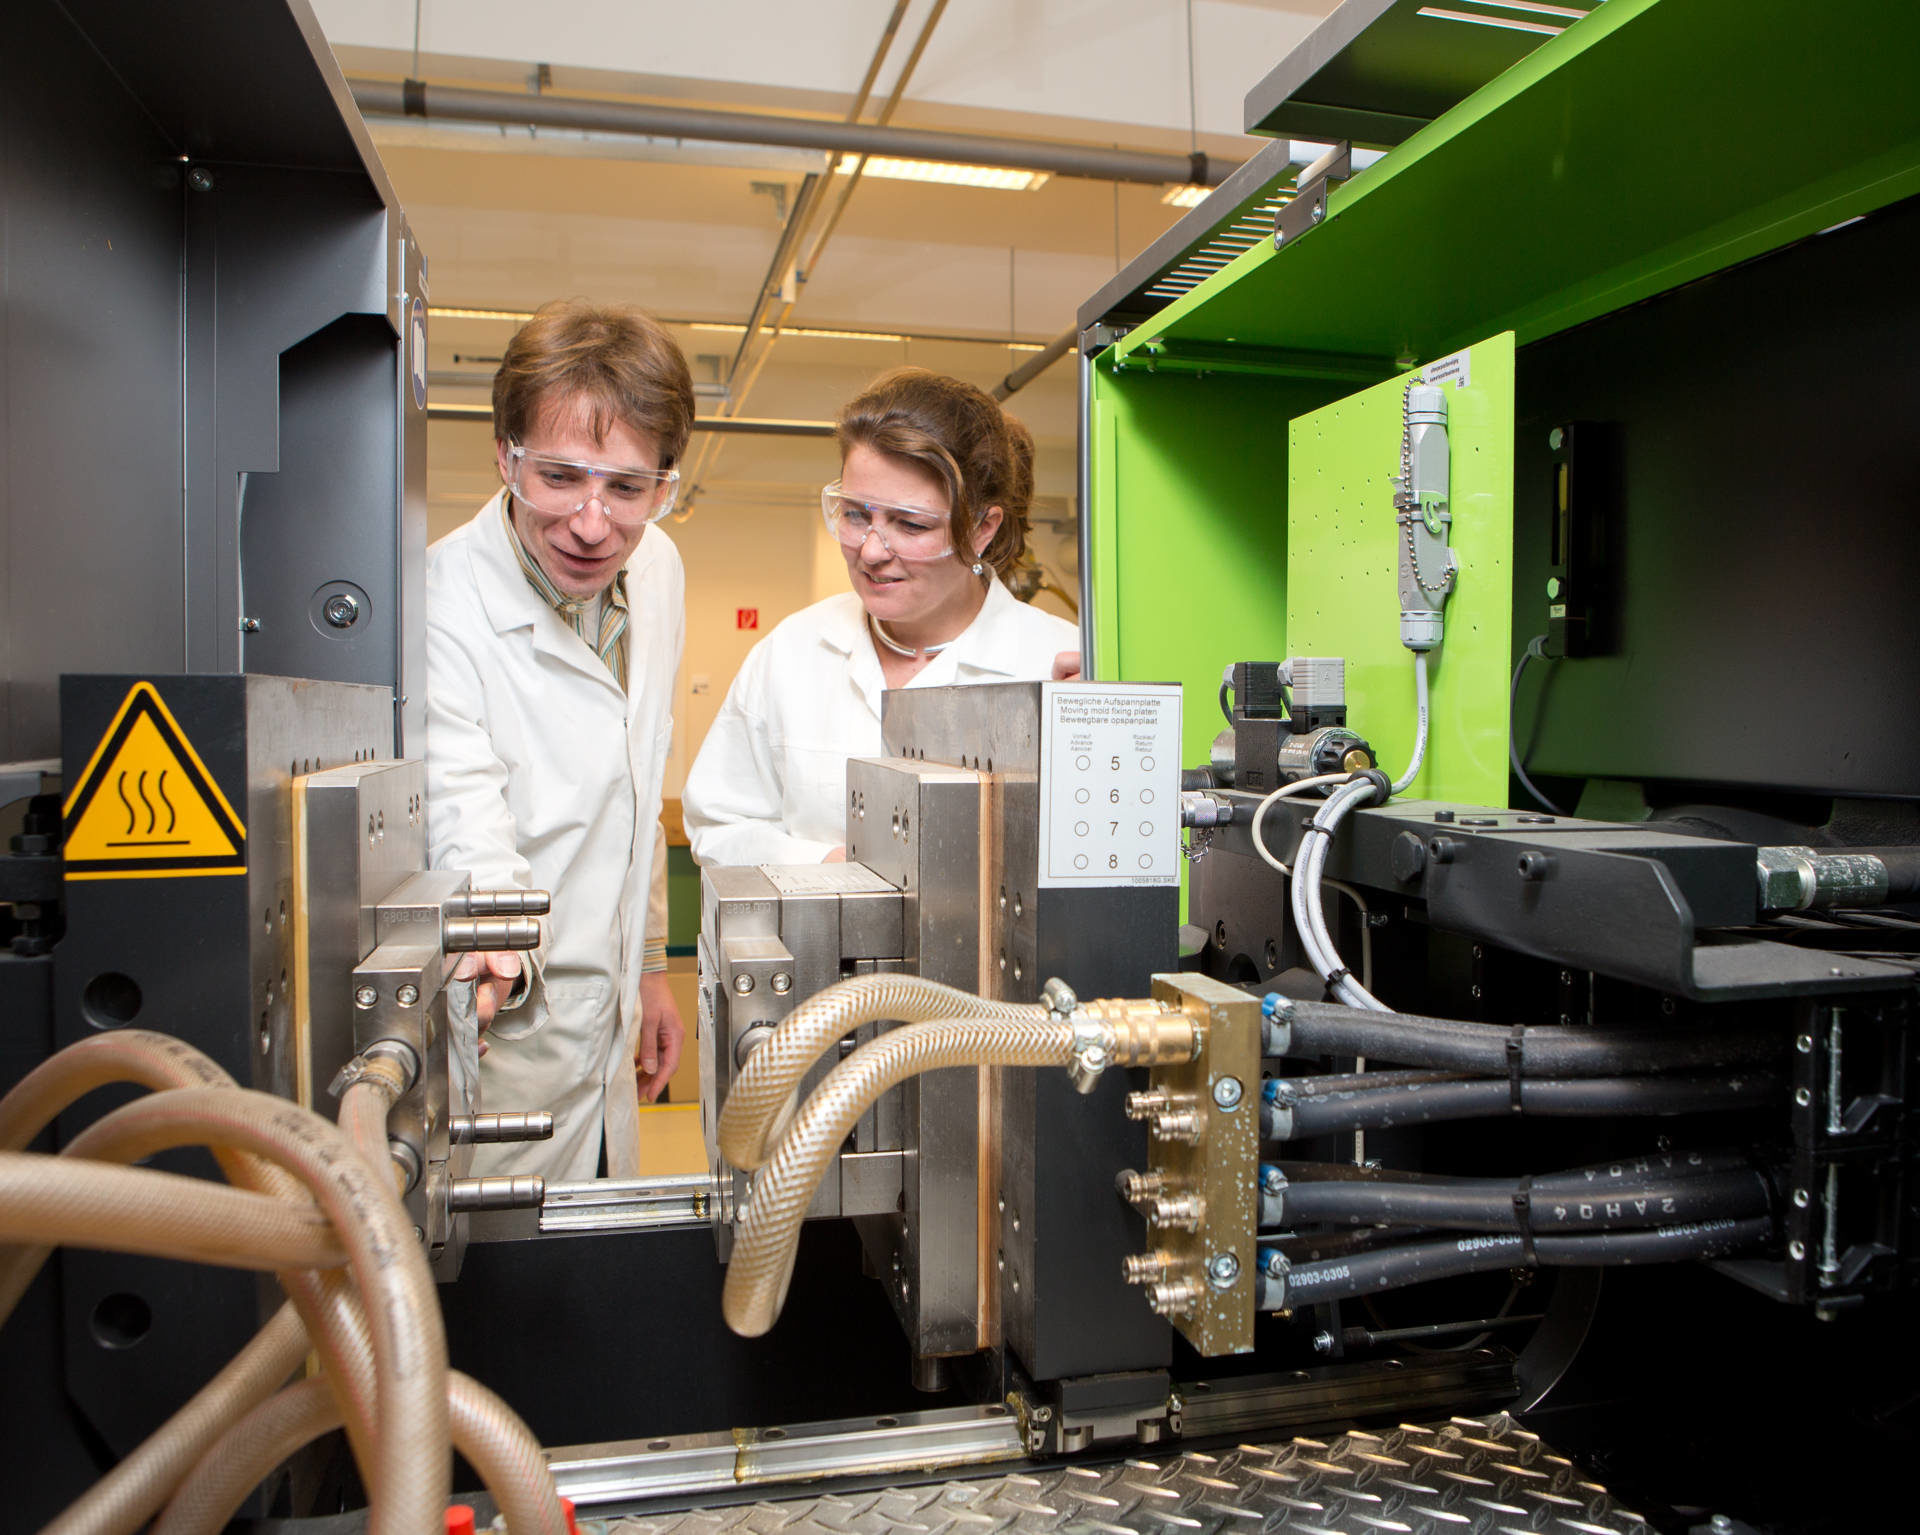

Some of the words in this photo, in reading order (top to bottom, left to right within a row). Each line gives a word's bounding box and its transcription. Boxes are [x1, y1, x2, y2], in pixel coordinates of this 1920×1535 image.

[1057, 696, 1101, 706] Bewegliche
[1103, 697, 1161, 707] Aufspannplatte
[1060, 706, 1088, 715] Moving
[1090, 706, 1109, 714] mold
[1111, 707, 1132, 716] fixing
[1134, 708, 1158, 716] platen
[1060, 715, 1109, 725] Beweegbare
[1111, 716, 1158, 725] opspanplaat
[1111, 755, 1120, 771] 5
[1110, 788, 1119, 804] 6
[1109, 821, 1119, 836] 7
[1109, 854, 1118, 869] 8
[1457, 1234, 1521, 1252] 02903-030
[1288, 1265, 1350, 1287] 02903-0305
